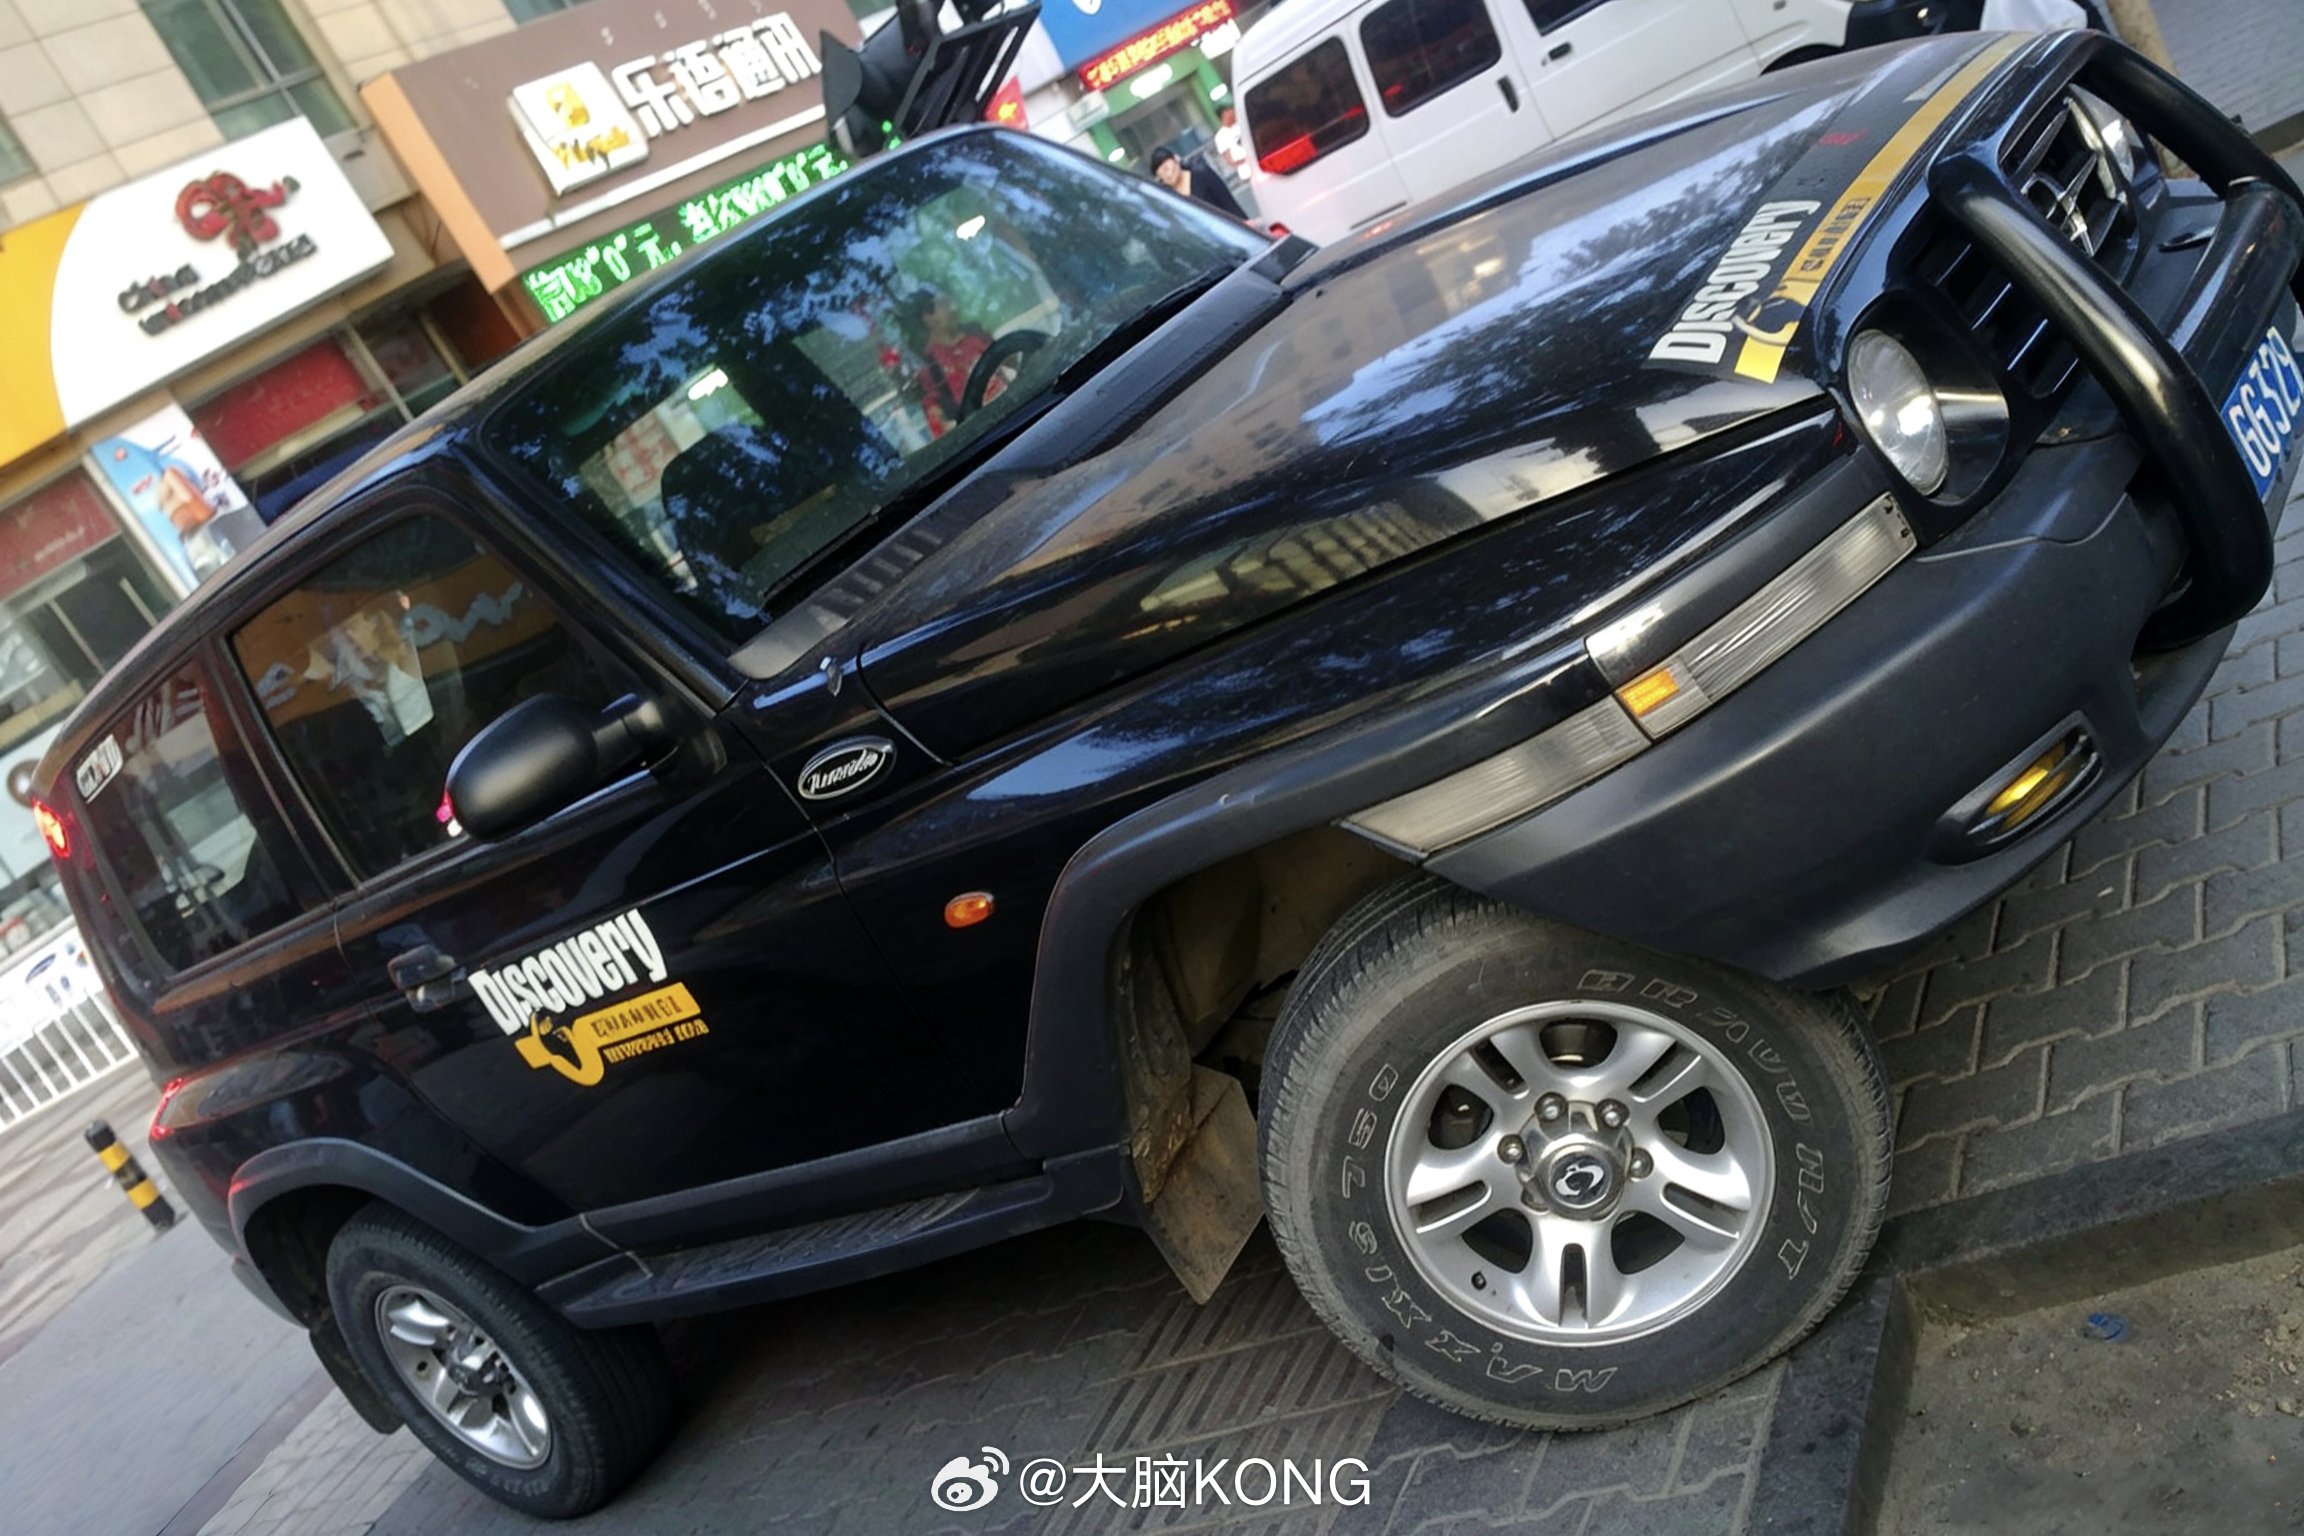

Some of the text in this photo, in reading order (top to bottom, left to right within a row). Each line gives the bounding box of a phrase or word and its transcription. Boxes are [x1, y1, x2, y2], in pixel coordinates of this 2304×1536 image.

[611, 11, 822, 138] 乐语通讯
[1348, 1220, 1618, 1393] MAXXIS
